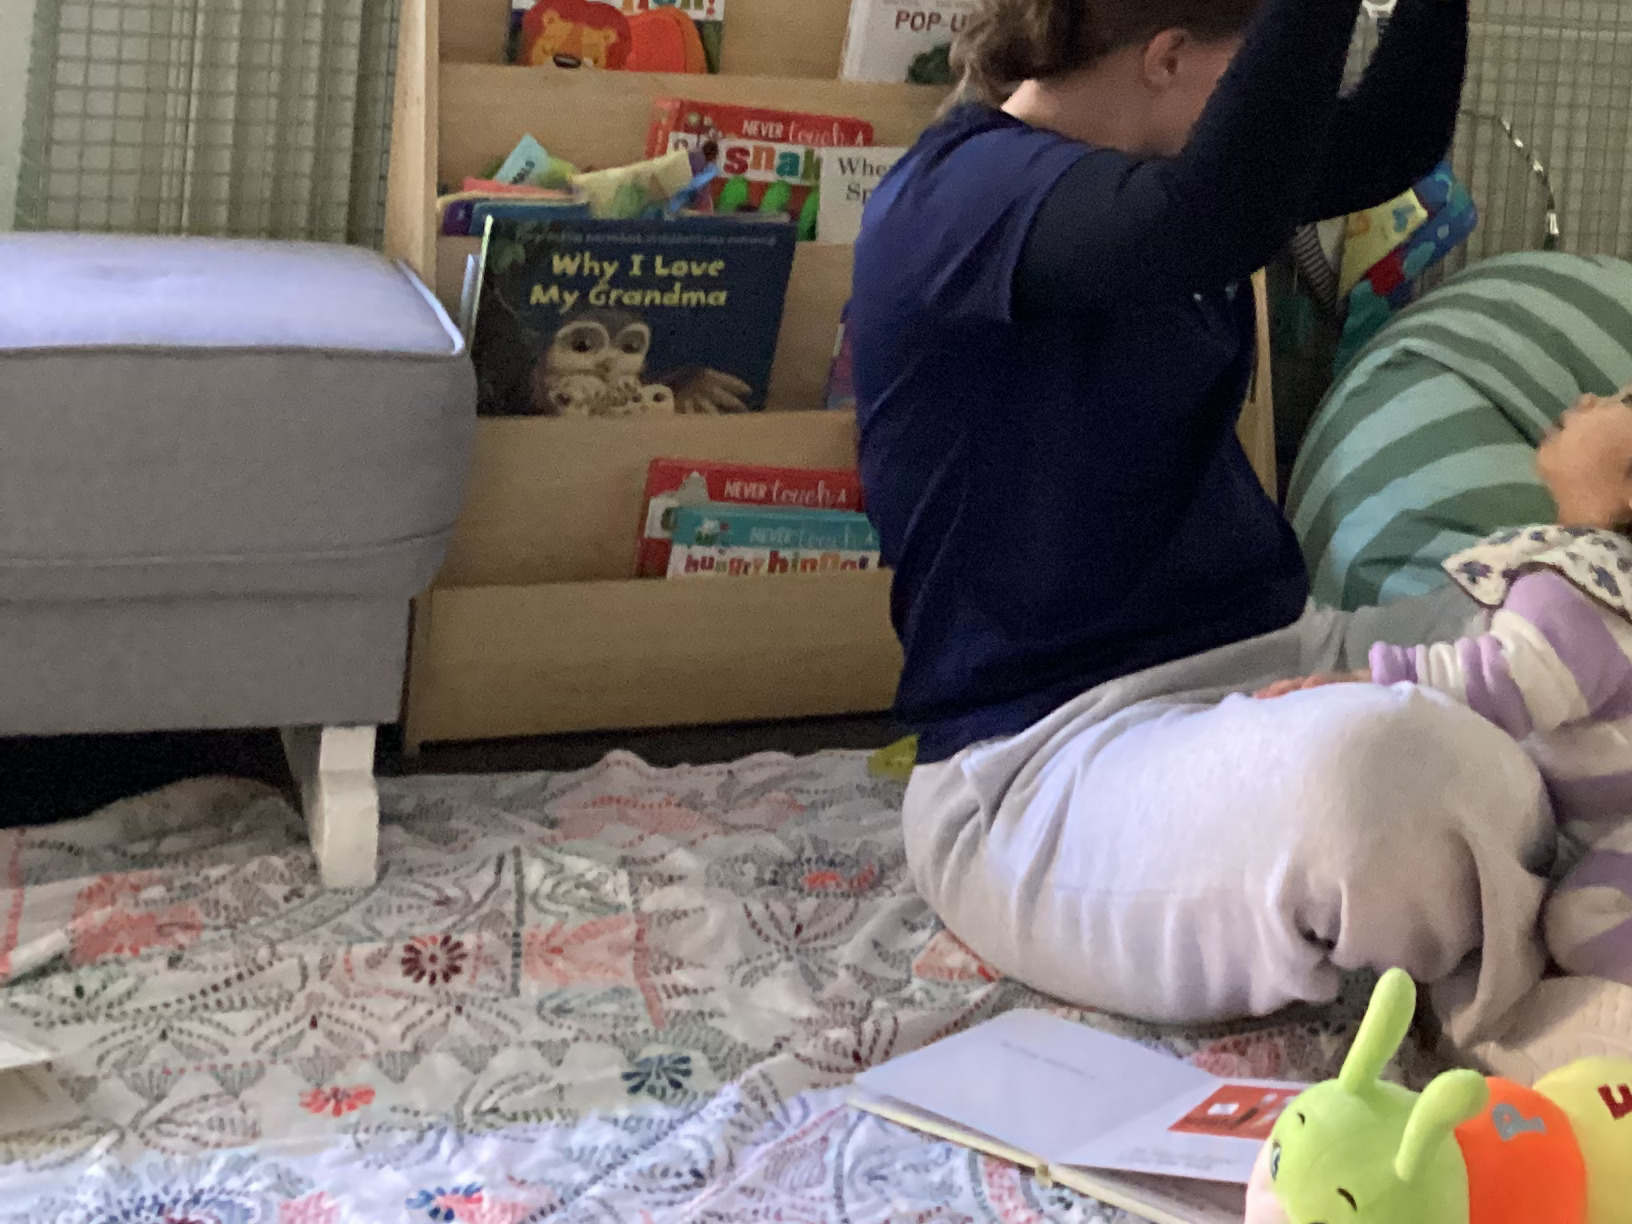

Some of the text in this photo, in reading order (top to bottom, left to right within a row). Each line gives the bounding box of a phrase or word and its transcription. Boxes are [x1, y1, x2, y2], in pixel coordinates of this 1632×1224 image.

[742, 119, 784, 140] NEVER
[788, 119, 847, 147] touch
[552, 251, 726, 282] Why I Love
[529, 280, 728, 315] My Grandma
[724, 479, 768, 500] NEVER
[771, 478, 834, 509] touch
